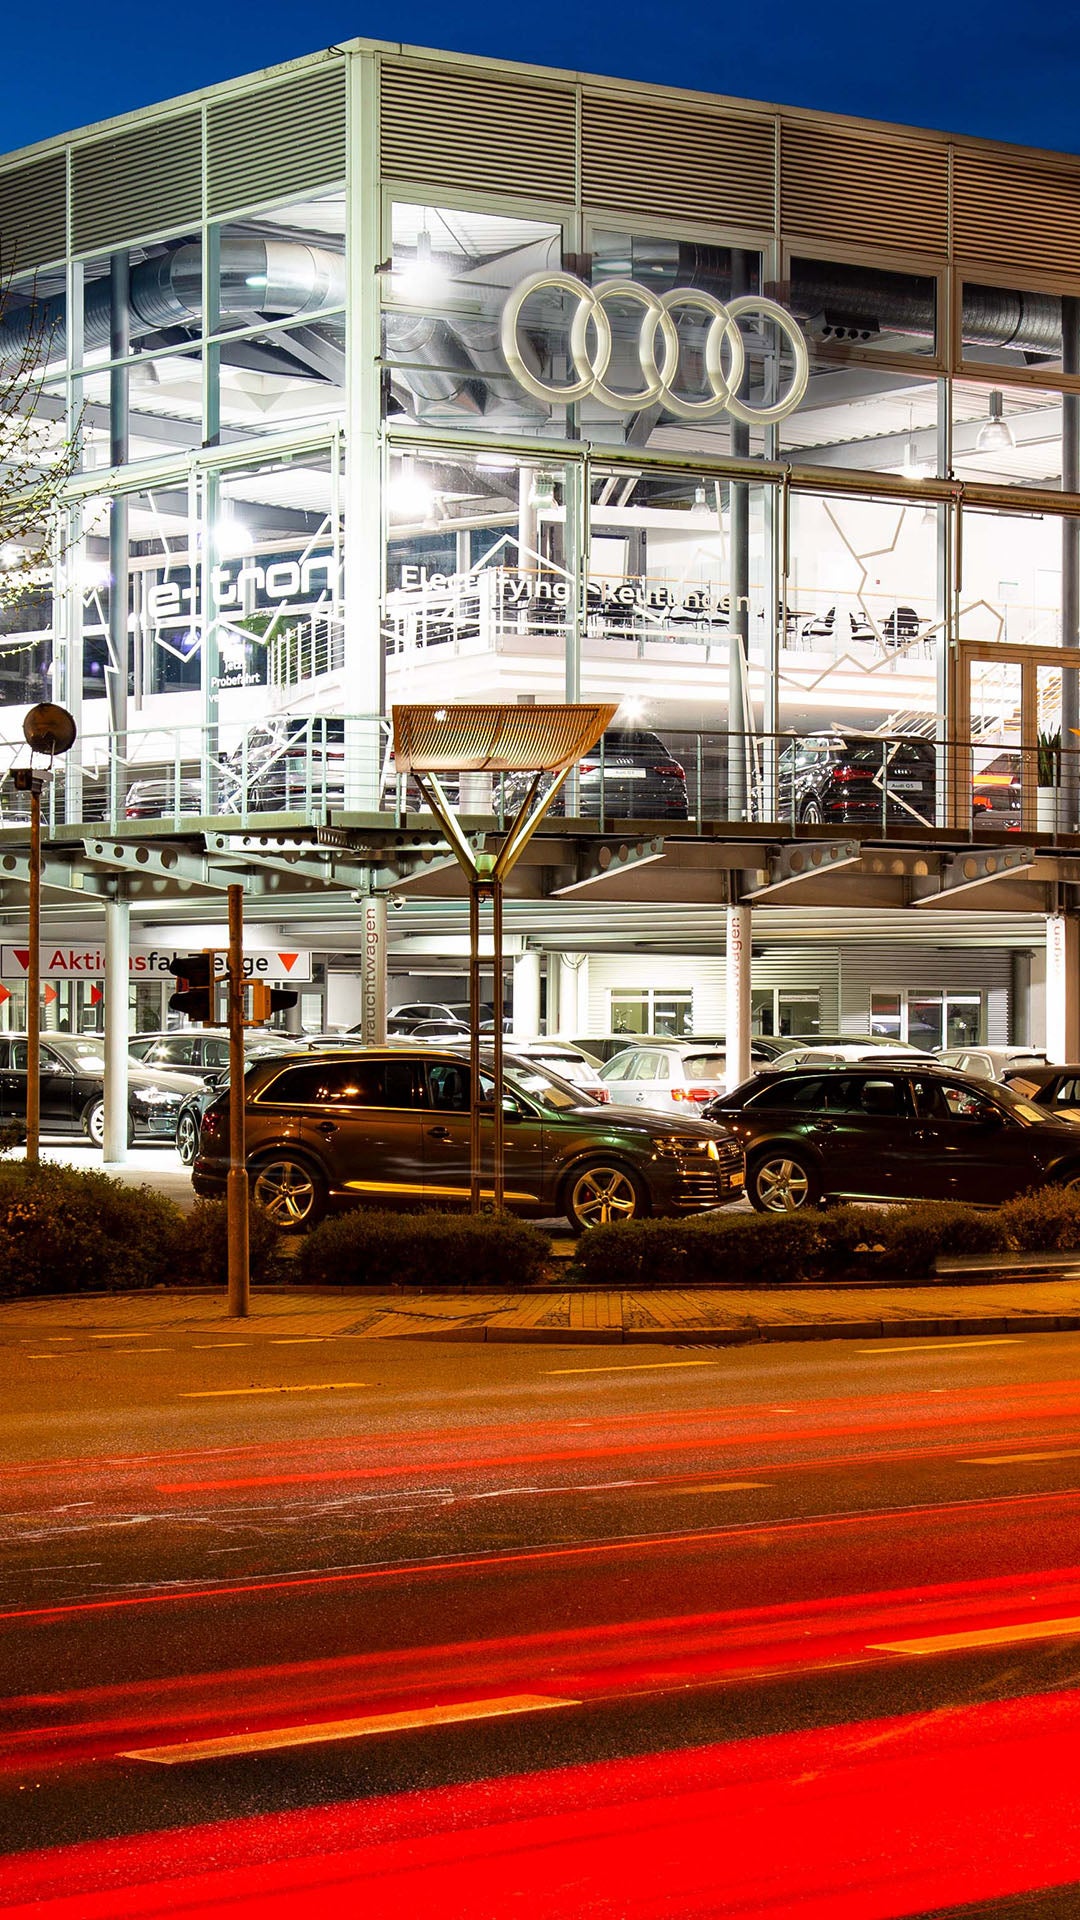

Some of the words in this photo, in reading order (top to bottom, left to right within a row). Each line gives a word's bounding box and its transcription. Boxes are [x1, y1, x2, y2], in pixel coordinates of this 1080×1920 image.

[148, 555, 338, 618] e-tron
[401, 564, 570, 605] Electfying
[49, 950, 268, 977] Aktisfaege
[365, 908, 378, 1045] rauchtwagen
